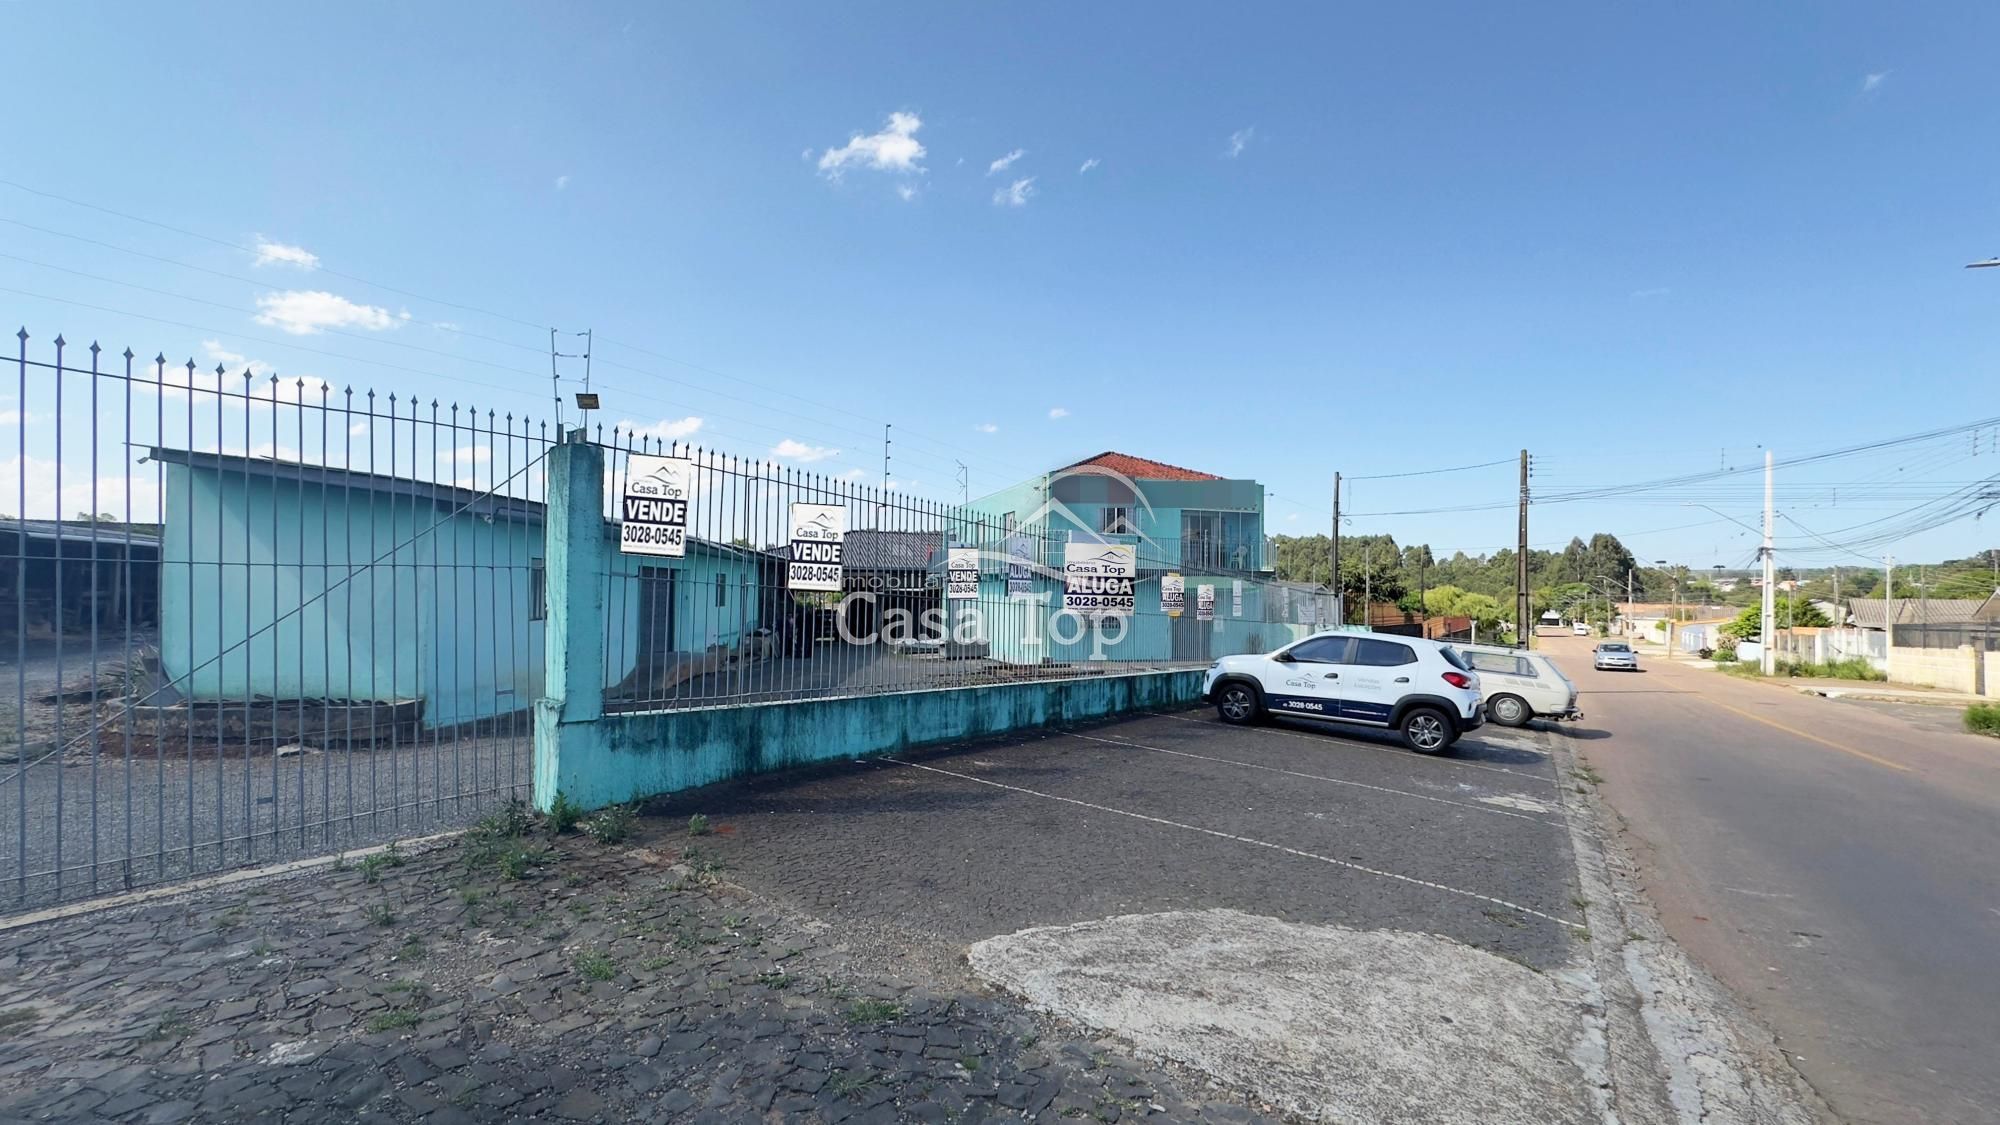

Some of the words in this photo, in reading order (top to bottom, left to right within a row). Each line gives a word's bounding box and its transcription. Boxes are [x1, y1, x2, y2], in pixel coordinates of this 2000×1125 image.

[631, 481, 658, 495] Casa
[662, 484, 682, 499] Top
[626, 498, 685, 523] VENDE
[623, 524, 682, 546] 3028-0545
[796, 527, 819, 538] Casa
[821, 528, 838, 541] Top
[792, 542, 840, 562] VENDE
[790, 564, 840, 582] 3028-0545
[949, 571, 978, 582] VENDE
[1066, 563, 1098, 573] Casa
[1101, 564, 1126, 576] Top
[1066, 575, 1133, 595] ALUGA
[1066, 596, 1134, 608] 3028-0545
[1304, 681, 1316, 690] Top
